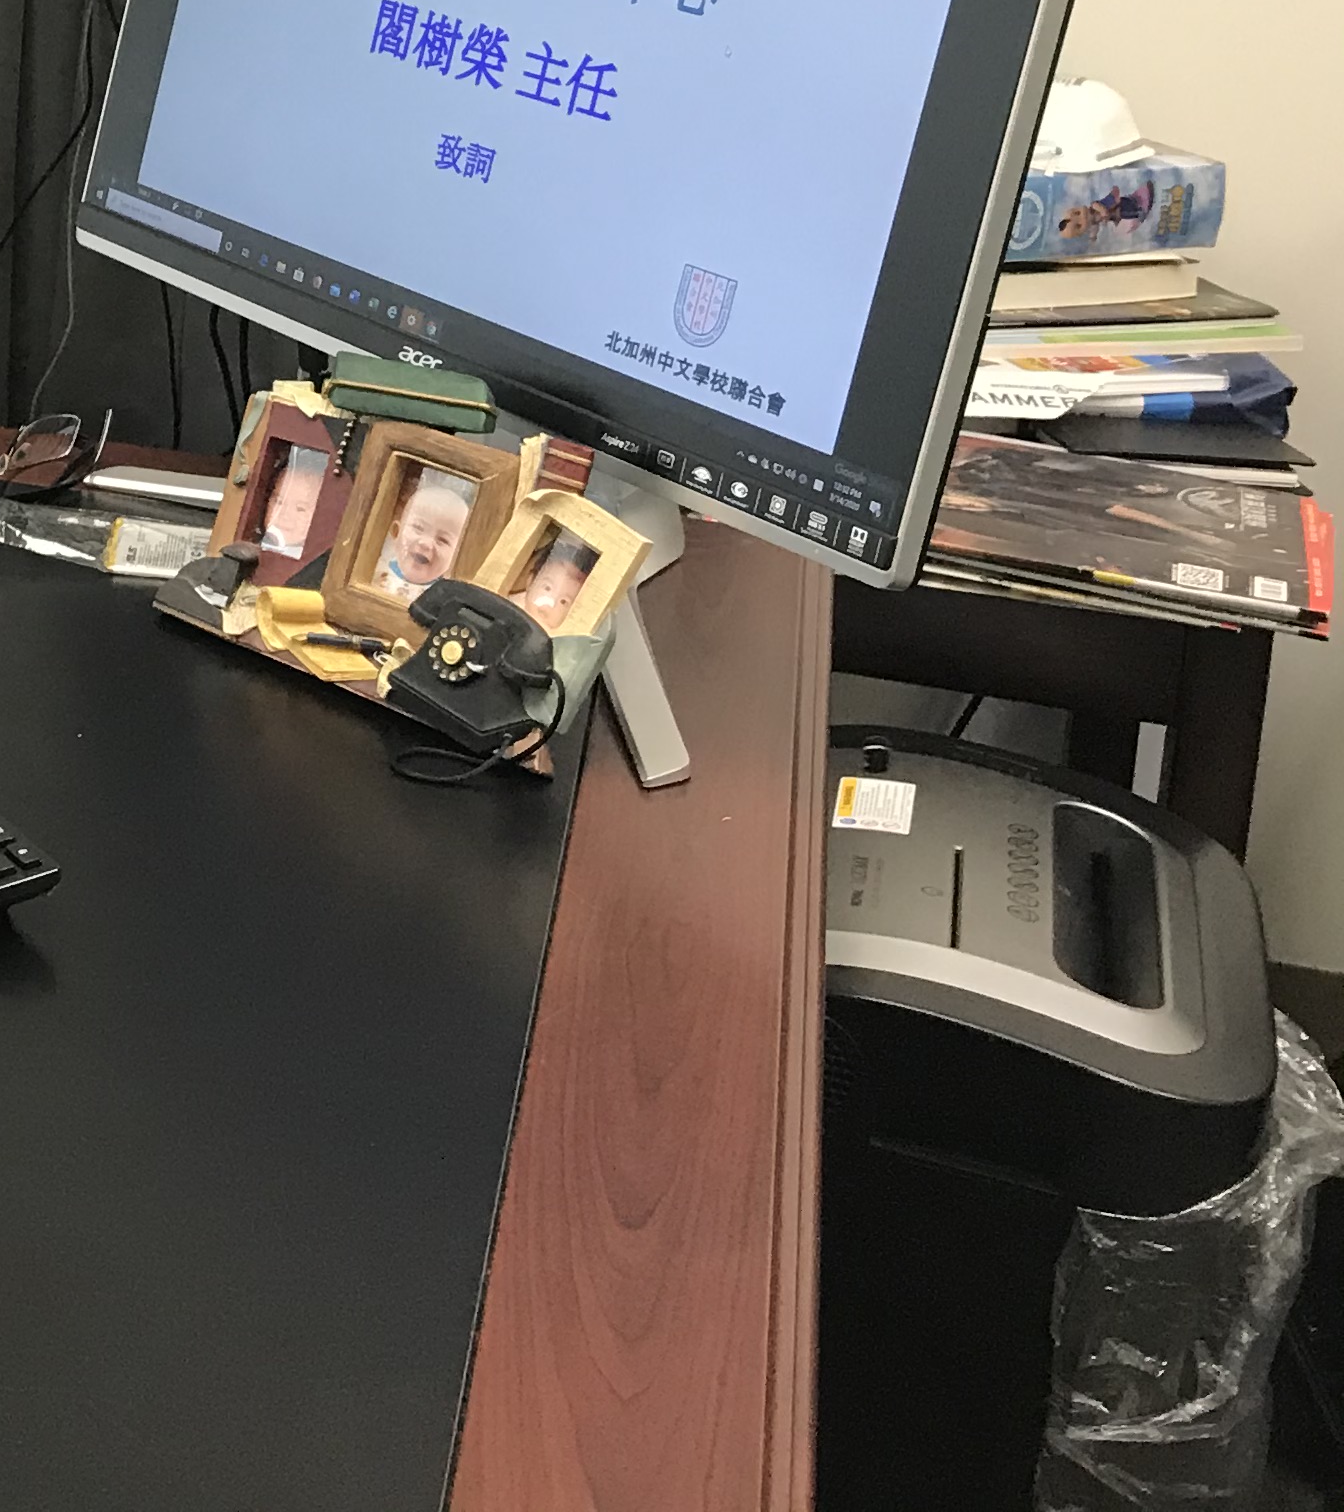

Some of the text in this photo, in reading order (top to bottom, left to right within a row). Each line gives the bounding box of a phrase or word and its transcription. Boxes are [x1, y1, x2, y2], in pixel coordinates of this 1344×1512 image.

[515, 41, 618, 121] 主任
[434, 134, 497, 183] 致詞
[398, 345, 443, 369] acer
[604, 330, 787, 417] 北加州中文學校聯合會
